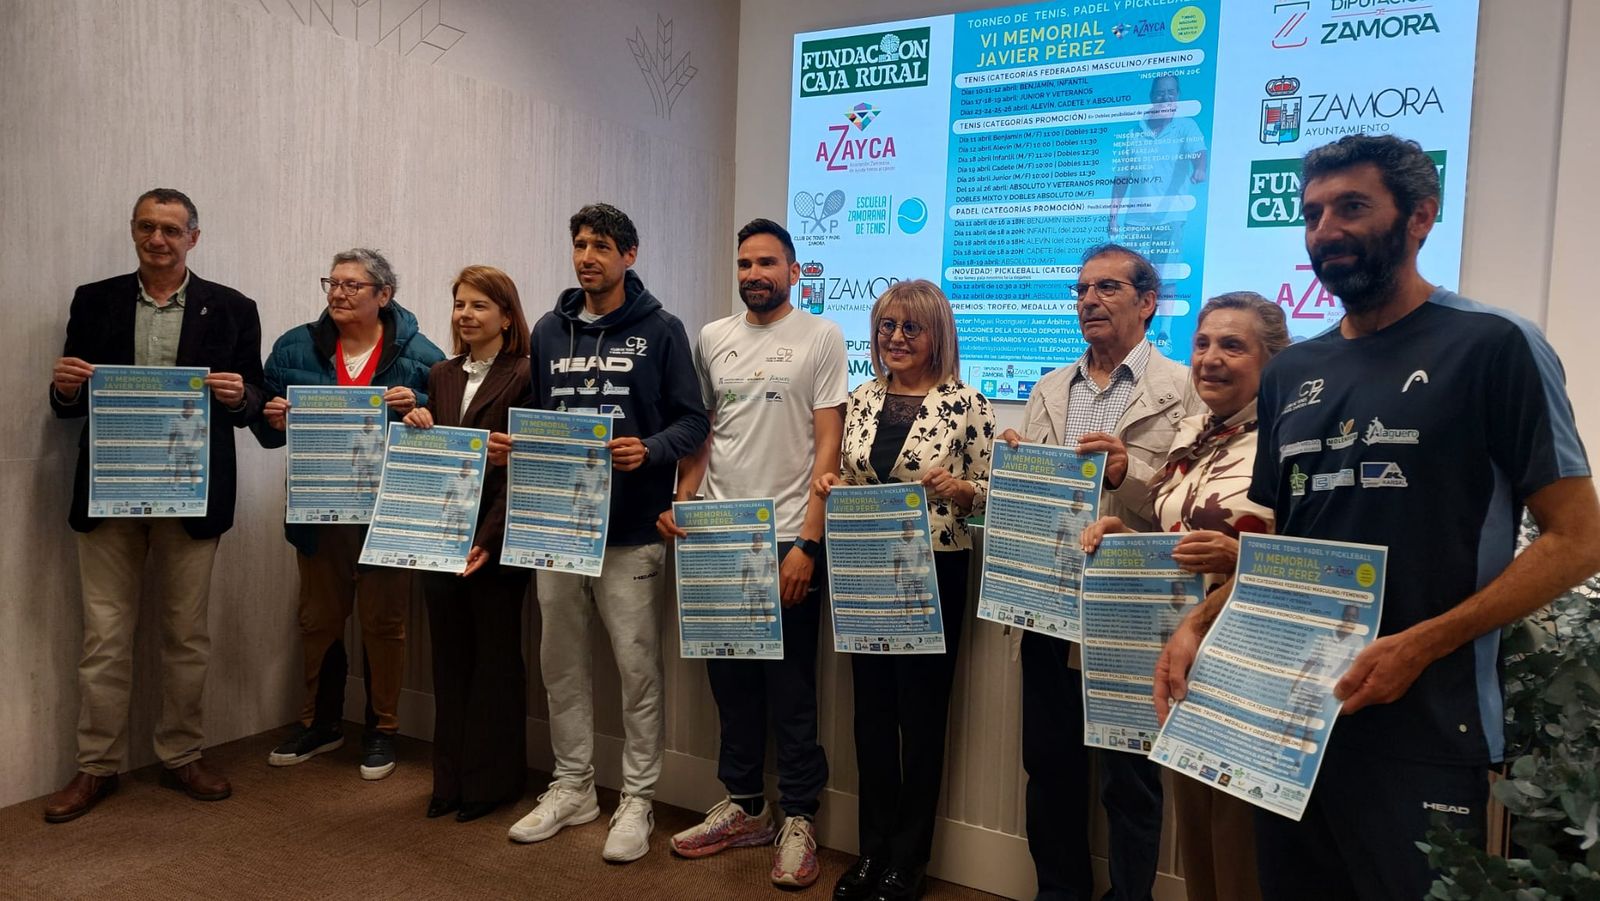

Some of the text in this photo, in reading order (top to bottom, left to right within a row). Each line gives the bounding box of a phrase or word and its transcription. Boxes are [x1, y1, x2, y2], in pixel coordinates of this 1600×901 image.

[968, 16, 1010, 28] TORNEO
[1015, 13, 1028, 23] DE
[1074, 4, 1110, 16] PADEL
[1114, 1, 1121, 10] Y
[981, 20, 1103, 48] VI MEMORIAL
[1133, 20, 1165, 37] AZAYCA
[1321, 13, 1440, 44] ZAMORA
[976, 40, 1105, 67] JAVIER PÉREZ
[964, 54, 1193, 83] TENIS (CATEGORÍAS FEDERADAS) MASCULINO/FEMENINO
[802, 62, 926, 92] CAJA RURAL
[1057, 78, 1088, 87] INFANTIL
[1052, 88, 1093, 97] VETERANOS
[1092, 95, 1131, 104] ABSOLUTO
[1307, 86, 1444, 122] ZAMORA
[983, 117, 1033, 128] (CATEGORÍAS
[1036, 112, 1087, 124] PROMOCIÓN)
[1305, 124, 1389, 136] AYUNTAMIENTO
[1010, 182, 1045, 190] ABSOLUTO
[1054, 180, 1093, 188] VETERANOS
[1096, 177, 1140, 186] PROMOCIÓN
[1037, 191, 1073, 199] ABSOLUTO
[857, 196, 886, 208] ESCUELA
[1034, 203, 1084, 212] PROMOCIÓN)
[848, 209, 886, 222] ZAMORANA
[856, 222, 885, 234] DE TENIS
[550, 356, 634, 374] HEAD
[1002, 461, 1028, 470] JAVIER
[1013, 454, 1055, 467] MEMORIAL
[1255, 553, 1320, 569] VI MEMORIAL
[1331, 550, 1371, 561] PICKLEBALL
[1252, 564, 1285, 577] JAVIER
[1423, 801, 1470, 815] HEAD
